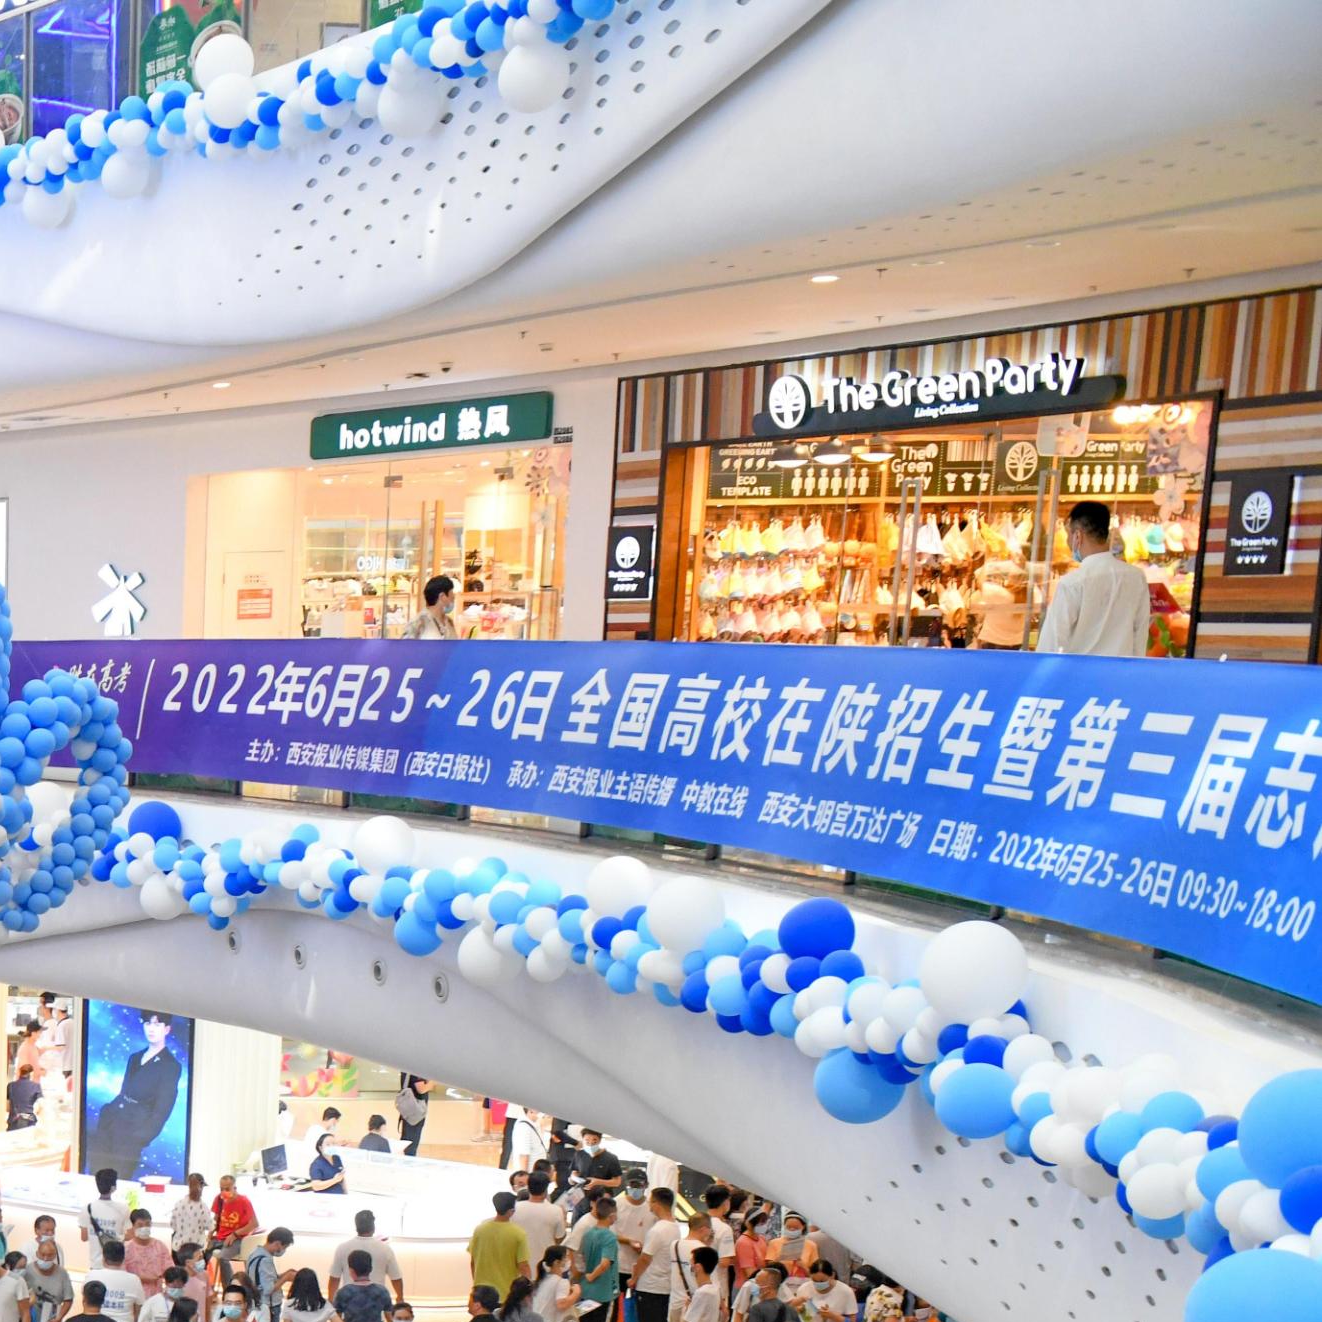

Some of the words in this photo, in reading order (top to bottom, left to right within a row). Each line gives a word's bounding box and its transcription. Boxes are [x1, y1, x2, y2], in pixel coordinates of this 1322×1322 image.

[822, 377, 878, 413] The
[882, 370, 983, 409] Green
[984, 352, 1085, 402] Party
[457, 404, 510, 440] 热风
[339, 413, 445, 451] hotwind
[901, 446, 925, 462] The
[1087, 440, 1119, 453] Green
[891, 459, 933, 474] Green
[736, 476, 758, 486] ECO
[720, 485, 772, 497] TEMPLATE
